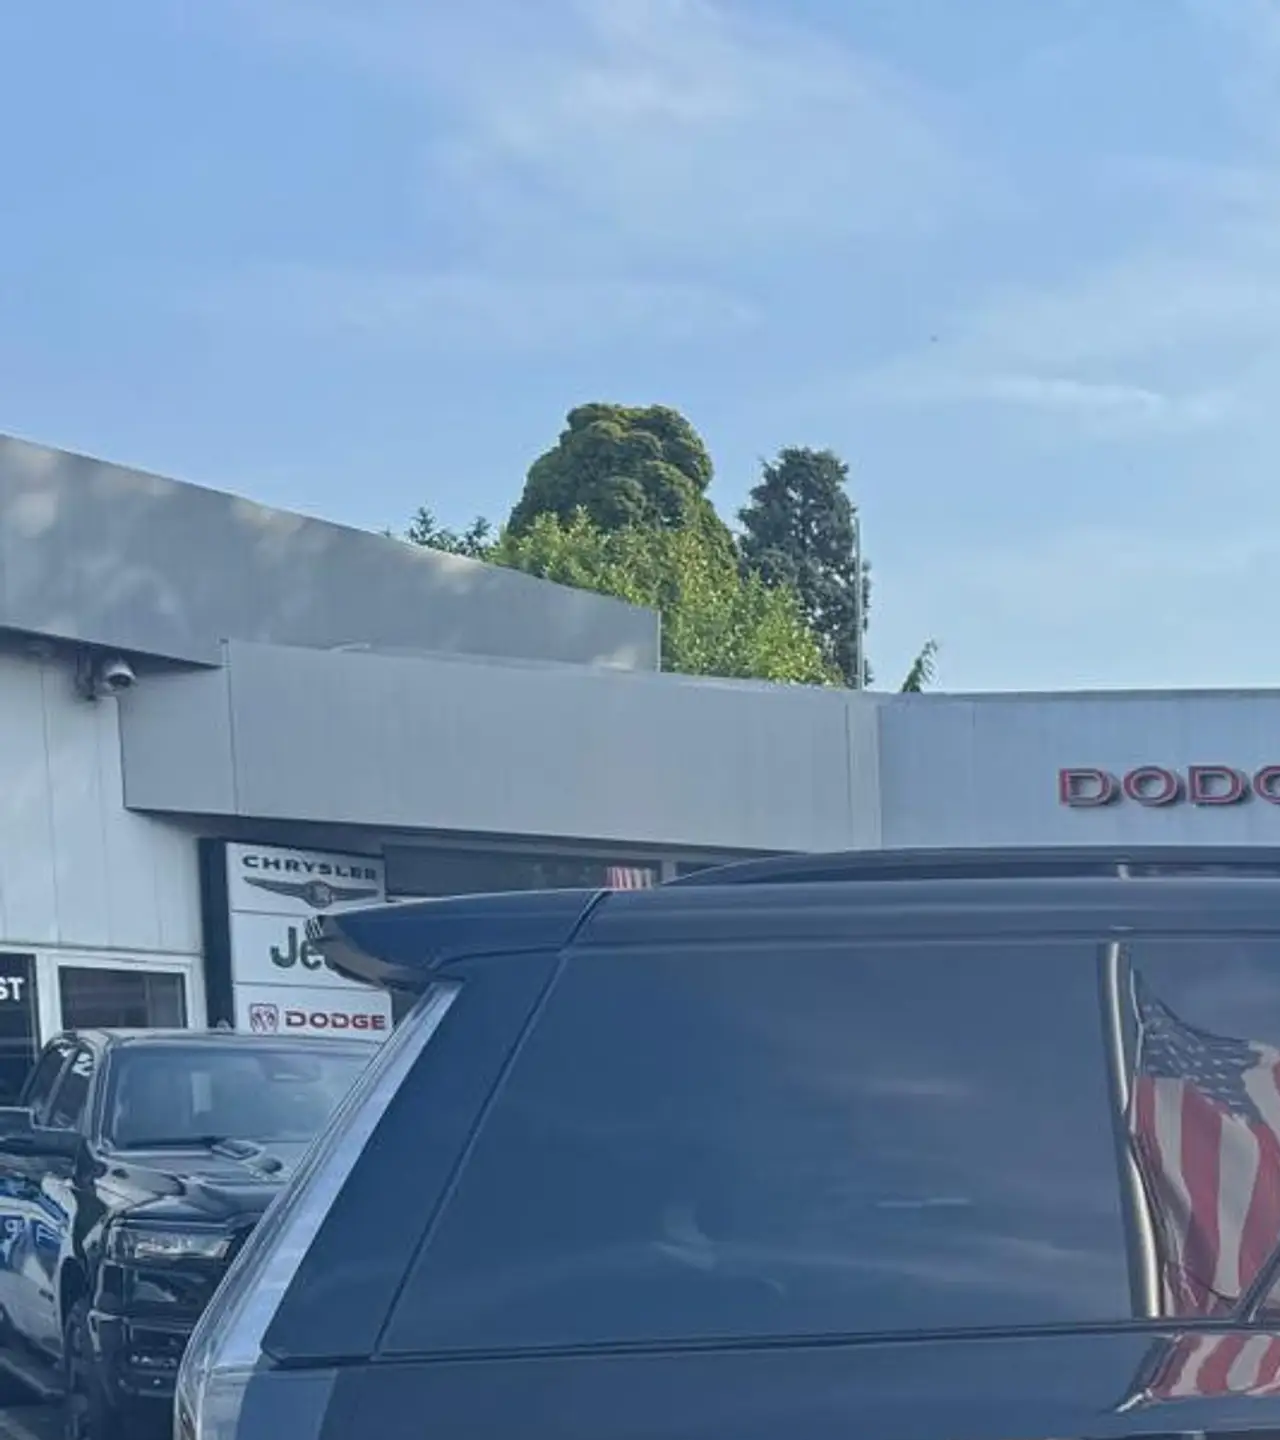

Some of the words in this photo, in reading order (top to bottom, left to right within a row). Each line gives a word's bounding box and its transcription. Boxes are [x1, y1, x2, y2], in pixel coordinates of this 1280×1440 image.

[241, 854, 377, 881] CHRYSLER
[270, 925, 323, 970] Je
[285, 1009, 386, 1031] DODGE
